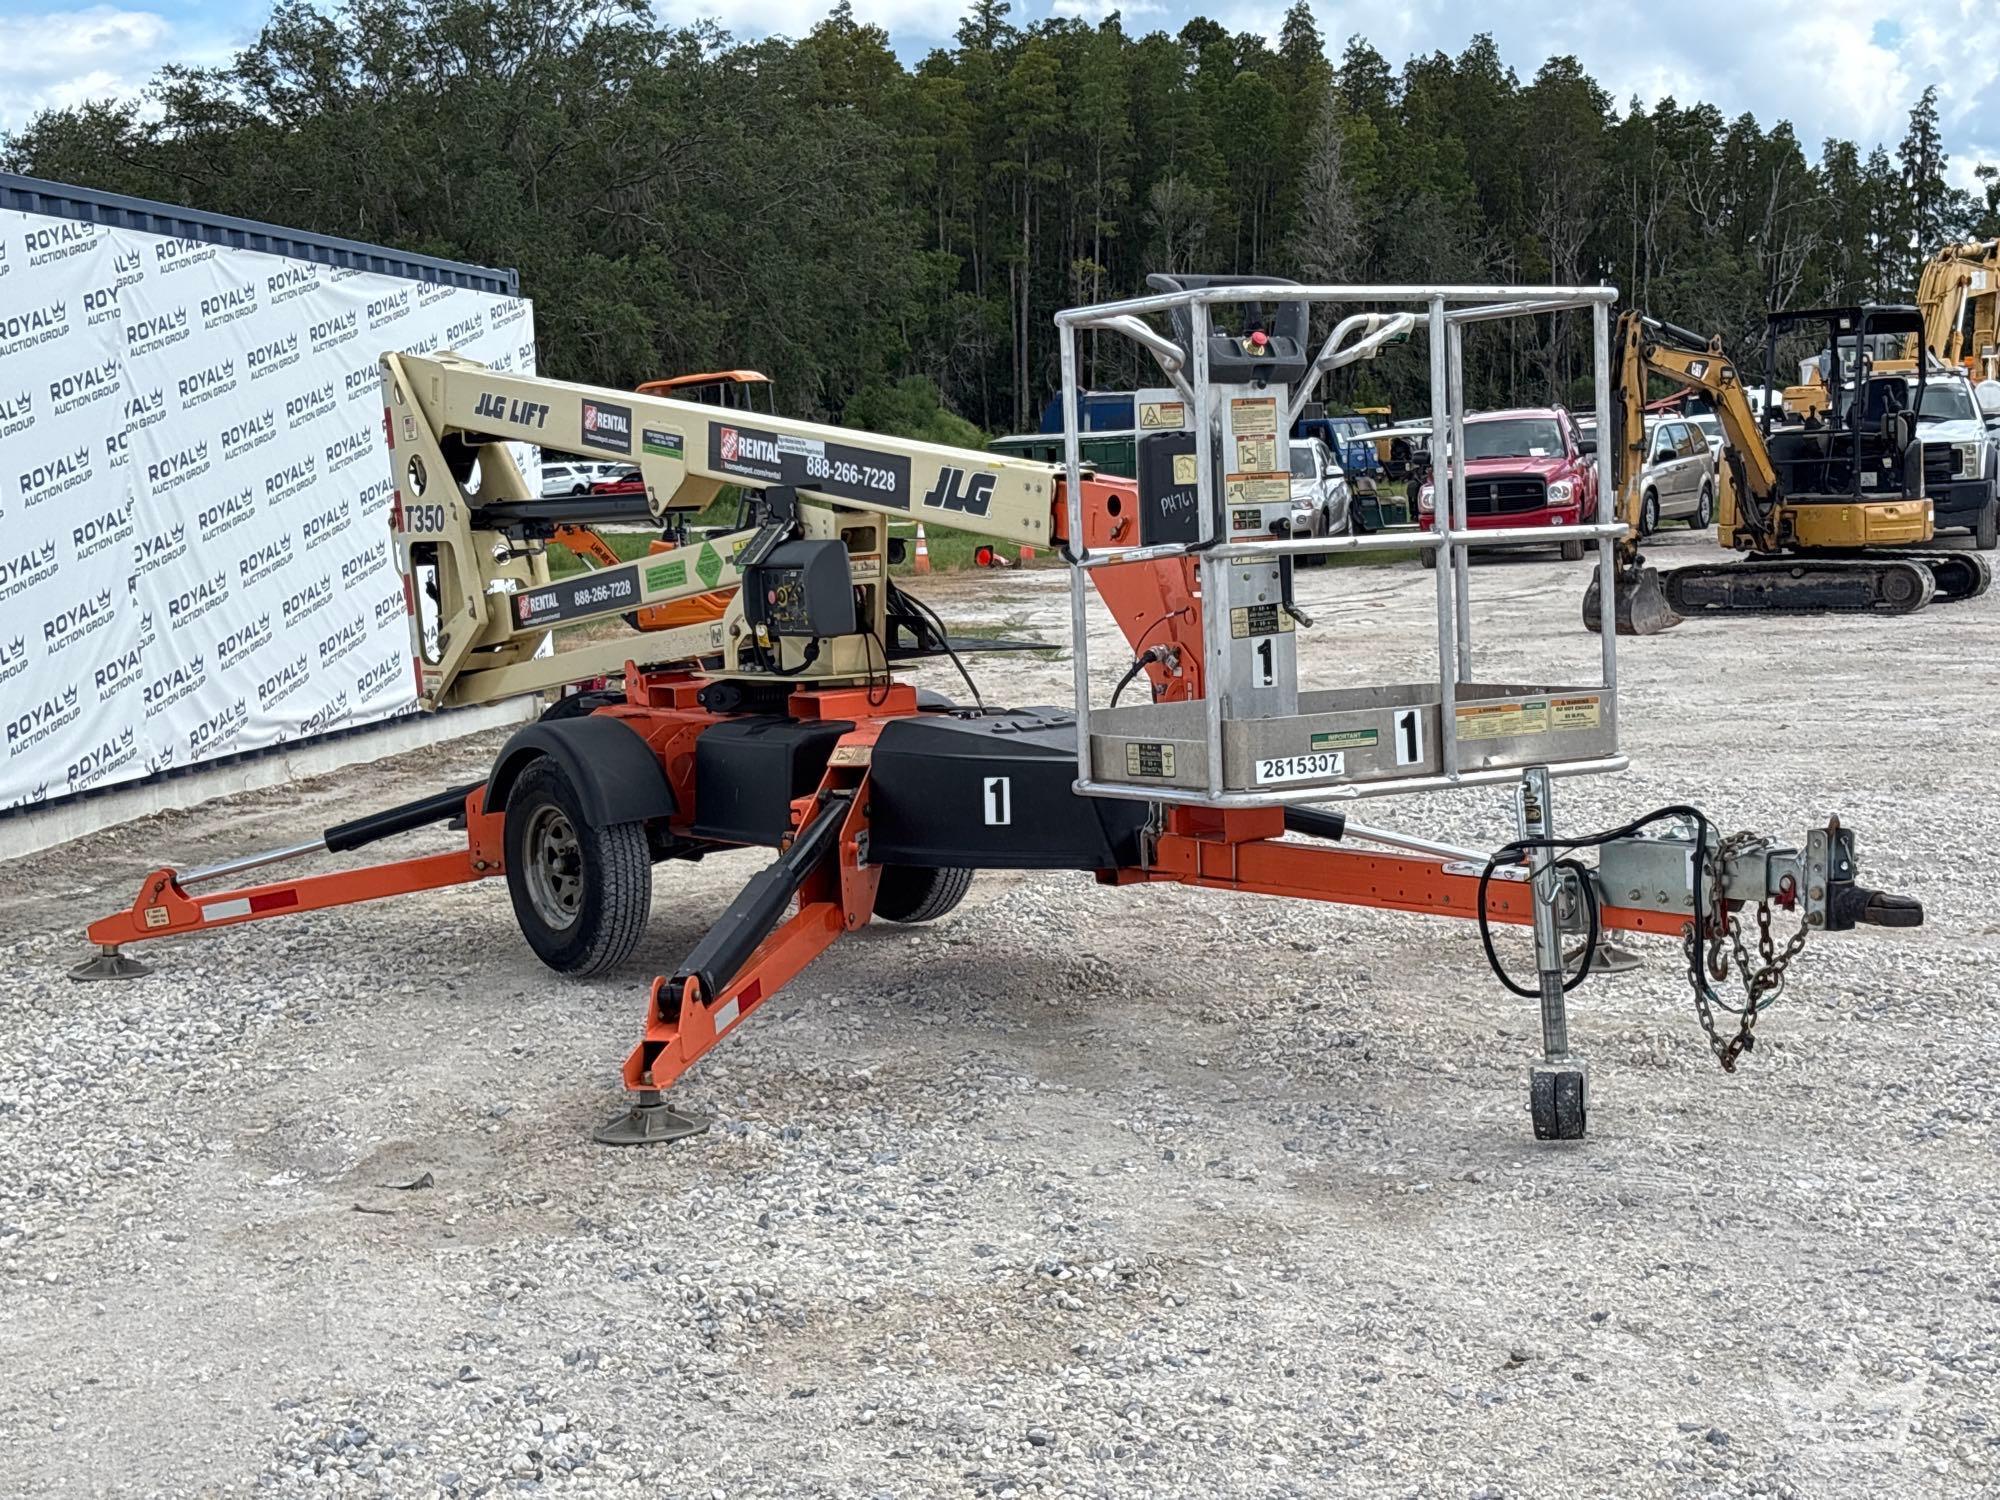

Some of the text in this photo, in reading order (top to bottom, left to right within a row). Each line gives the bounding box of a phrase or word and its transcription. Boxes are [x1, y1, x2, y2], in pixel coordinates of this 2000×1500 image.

[25, 222, 82, 253] ROYAL
[30, 239, 97, 267] AUCTION GROUP
[160, 257, 191, 275] AUCTION
[268, 266, 308, 293] ROYAL
[84, 286, 117, 312] ROY
[201, 289, 244, 317] ROYAL
[272, 281, 320, 305] AUCTION GROUP
[367, 294, 401, 318] ROYAL
[88, 308, 121, 326] AUCTIO
[205, 304, 258, 330] AUCTION GROUP
[370, 306, 410, 330] AUCTION GROUP
[490, 299, 518, 320] ROYAL
[40, 325, 69, 343] GROUP
[127, 312, 176, 344] ROYAL
[130, 328, 190, 358] AUCTION GROUP
[310, 316, 348, 342] ROYAL
[313, 329, 358, 354] AUCTION GROUP
[447, 318, 476, 342] ROYAL
[469, 329, 484, 342] GROUP
[248, 338, 290, 368] ROYAL
[251, 353, 300, 381] AUCTION GROUP
[50, 368, 104, 402] ROYAL
[178, 366, 223, 397] ROYAL
[182, 380, 236, 410] AUCTION GROUP
[55, 382, 120, 416] AUCTION GROUP
[124, 394, 152, 419] YAL
[286, 389, 324, 418] ROYAL
[475, 393, 549, 428] JLG LIFT
[4, 416, 35, 437] GROUP
[290, 401, 336, 429] AUCTION GROUP
[597, 412, 628, 433] RENTAL
[222, 417, 264, 448] ROYAL
[225, 430, 276, 461] AUCTION GROUP
[326, 432, 364, 462] ROYAL
[148, 448, 196, 482] ROYAL
[329, 444, 373, 474] AUCTION GROUP
[739, 437, 781, 464] RENTAL
[20, 456, 76, 494] ROYAL
[25, 470, 92, 509] AUCTION GROUP
[152, 461, 210, 496] AUCTION GROUP
[266, 463, 305, 494] ROYAL
[806, 456, 895, 492] 888-266-7228
[269, 474, 316, 506] AUCTION GROUP
[923, 466, 999, 518] JLG
[73, 507, 127, 547] ROYAL
[199, 496, 242, 530] ROYAL
[202, 507, 255, 542] AUCTION GROUP
[303, 508, 340, 540] ROYAL
[405, 505, 445, 533] T350
[77, 526, 133, 561] AUCTION GRO
[134, 532, 172, 563] OYAL
[306, 518, 351, 551] AUCTION GROUP
[0, 550, 42, 585] OYAL
[162, 544, 186, 565] GROUP
[240, 542, 281, 576] ROYAL
[342, 548, 377, 579] ROYAL
[28, 564, 58, 586] GROUP
[243, 553, 293, 589] AUCTION GROUP
[344, 558, 387, 591] AUCTION GROUP
[169, 578, 216, 618] ROYAL
[282, 583, 322, 617] ROYAL
[375, 594, 404, 620] ROYA
[530, 592, 559, 612] RENTAL
[574, 580, 631, 606] 888-266-7228
[44, 599, 98, 641] ROYAL
[172, 591, 229, 631] AUCTION GROUP
[286, 593, 333, 629] AUCTION GROUP
[48, 610, 114, 656] AUCTION GROUP
[218, 622, 260, 660] ROYAL
[319, 621, 356, 658] ROYAL
[221, 632, 272, 672] AUCTION GROUP
[322, 632, 366, 670] AUCTION GROUP
[1257, 639, 1273, 685] 1
[100, 674, 135, 703] AUCTION
[258, 664, 294, 701] ROYAL
[263, 672, 310, 712] AUCTION GROUP
[358, 660, 392, 694] ROYAL
[361, 682, 384, 704] AUCTION
[384, 664, 402, 686] GROUP
[7, 697, 64, 744] ROYAL
[146, 692, 179, 719] AUCTION
[10, 707, 80, 758] AUCTION GROUP
[190, 708, 234, 749] ROYAL
[1328, 732, 1360, 741] IMPORTANT
[1401, 711, 1417, 762] 1
[67, 738, 122, 784] ROYAL
[108, 747, 137, 772] GROUP
[1263, 754, 1338, 778] 2815307
[989, 780, 1003, 823] 1
